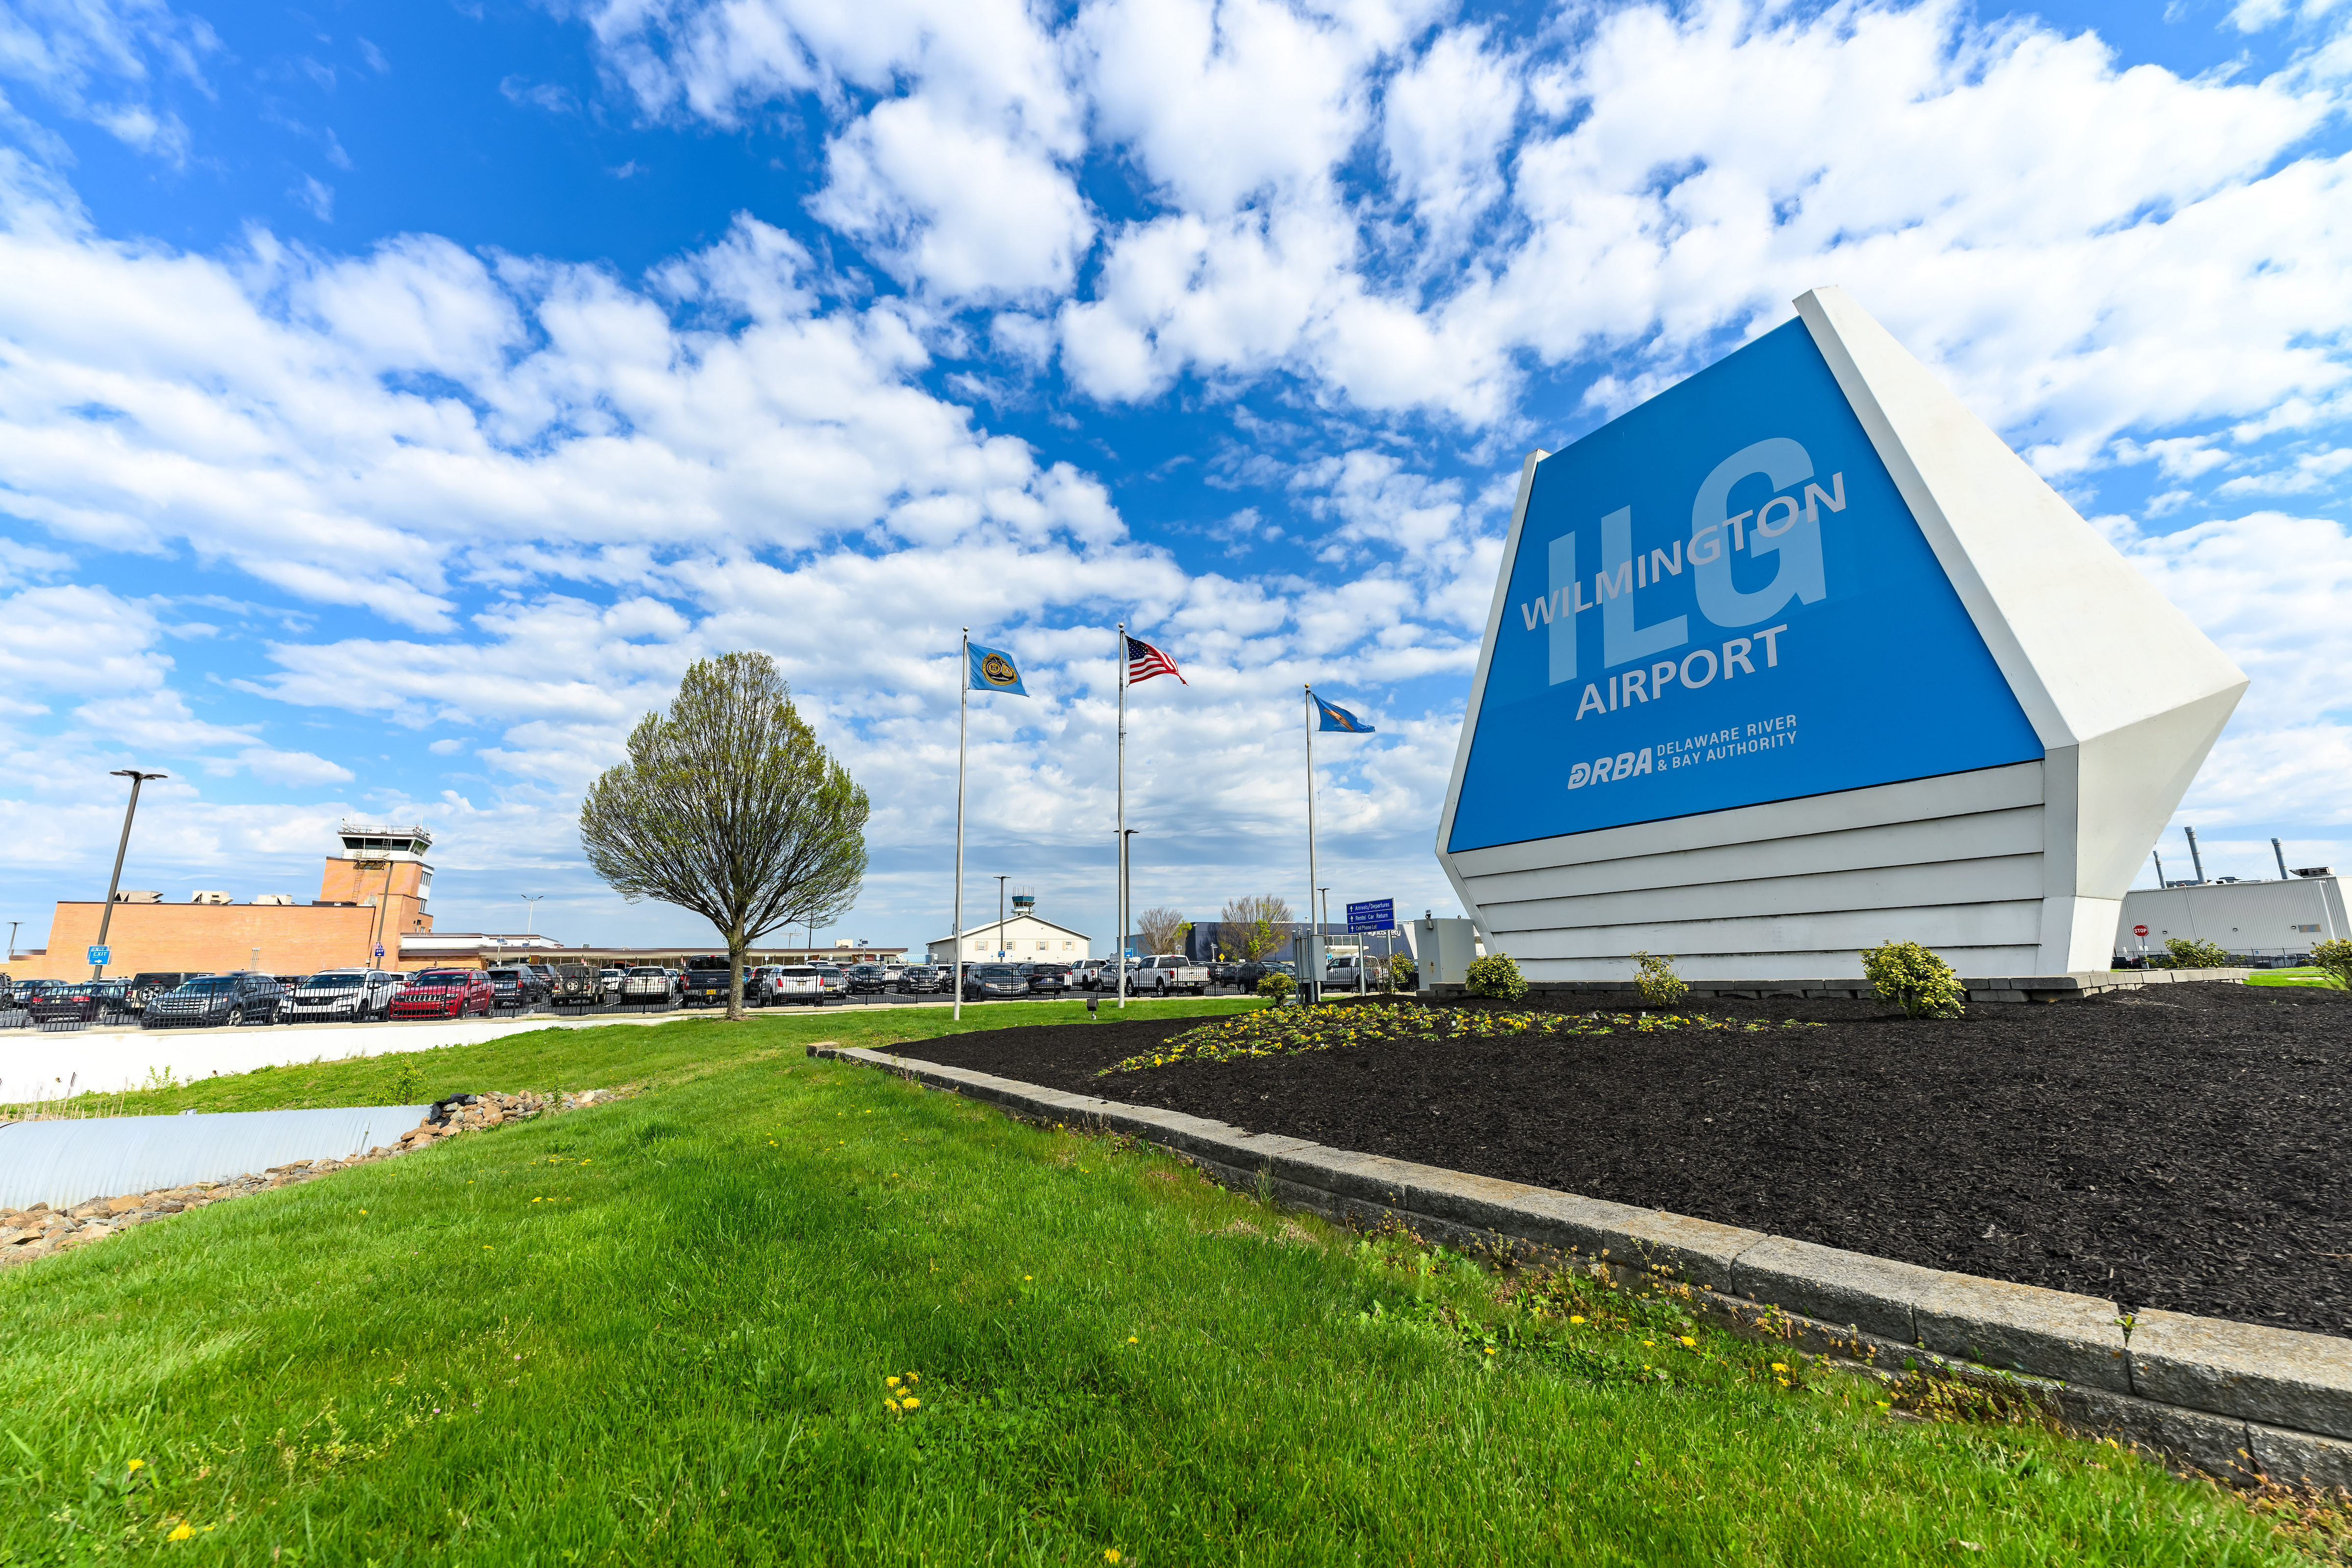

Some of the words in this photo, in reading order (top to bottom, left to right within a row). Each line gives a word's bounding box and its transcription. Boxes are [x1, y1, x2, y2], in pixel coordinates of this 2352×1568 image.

[1521, 471, 1846, 631] WILMINGTON
[1548, 437, 1827, 686] ILG
[1575, 624, 1788, 721] AIRPORT
[1657, 727, 1740, 757] DELAWARE
[1747, 714, 1797, 737] RIVER
[1657, 759, 1667, 771] &
[1672, 751, 1701, 769] BAY
[1706, 730, 1797, 762] AUTHORITY
[1567, 747, 1652, 790] DRBA
[1355, 903, 1390, 911] Arrivals/Departures
